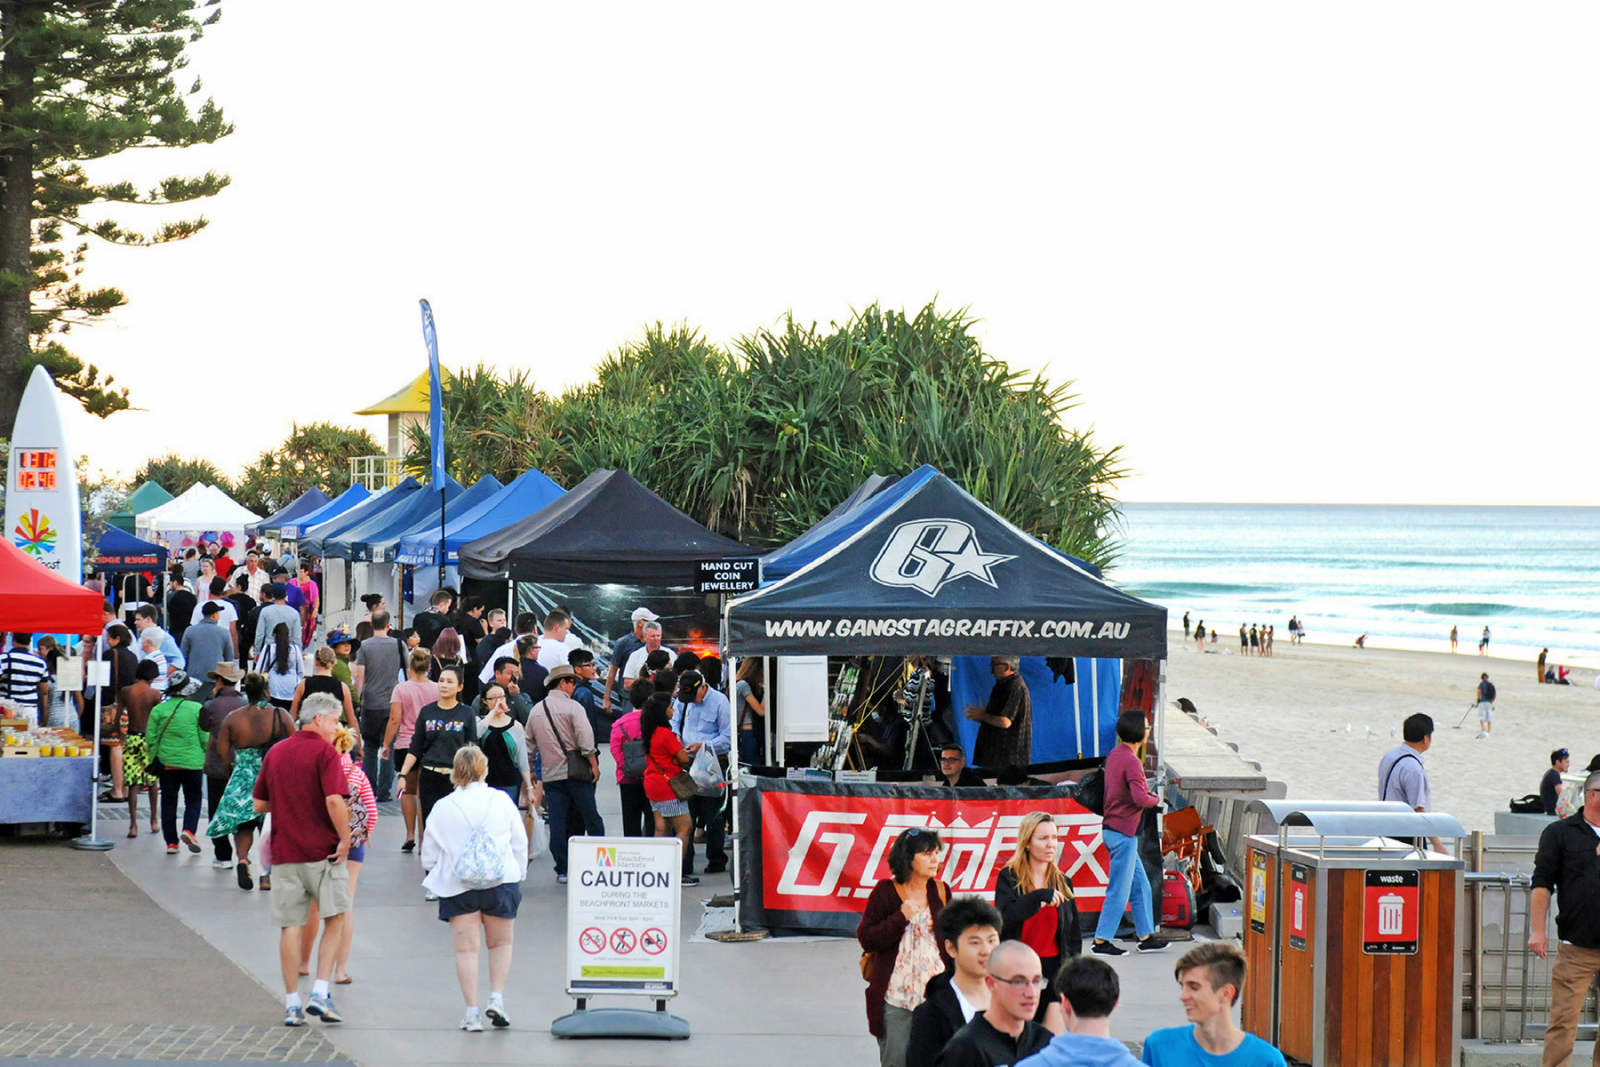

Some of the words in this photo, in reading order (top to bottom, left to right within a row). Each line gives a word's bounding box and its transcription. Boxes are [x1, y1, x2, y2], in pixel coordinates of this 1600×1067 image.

[93, 556, 121, 564] IDGE
[124, 556, 158, 564] RYDER
[701, 562, 731, 571] HAND
[733, 561, 754, 570] CUT
[714, 572, 741, 580] COIN
[701, 582, 754, 592] JEWELLERY
[765, 618, 1131, 640] WWW.GANGSTAGRAFFIX.COM.AU
[581, 870, 669, 888] CAUTION
[1380, 875, 1403, 883] waste
